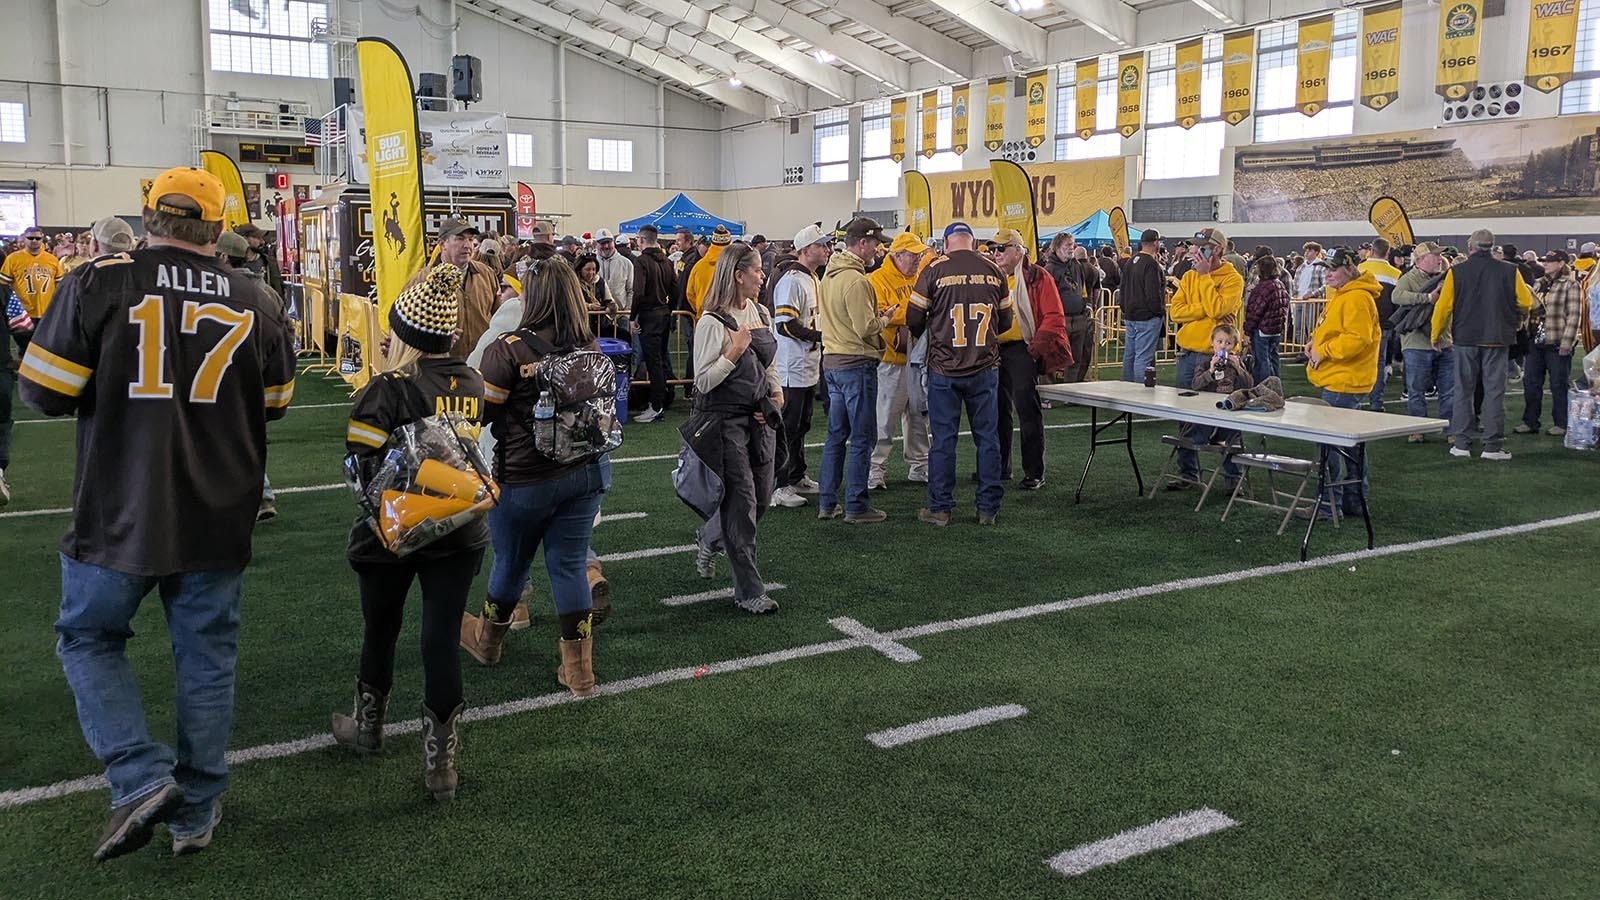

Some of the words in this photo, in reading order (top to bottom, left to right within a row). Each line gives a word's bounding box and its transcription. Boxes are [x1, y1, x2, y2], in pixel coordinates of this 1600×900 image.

[1535, 0, 1576, 18] WAC
[1365, 28, 1398, 45] WAC
[1532, 45, 1572, 58] 1967
[1441, 55, 1477, 69] 1966
[1364, 67, 1396, 80] 1966
[1300, 77, 1326, 88] 1961
[1178, 94, 1200, 105] 1959
[1224, 87, 1250, 99] 1960
[1078, 108, 1097, 118] 1958
[1119, 104, 1140, 114] 1958
[1028, 117, 1045, 126] 1956
[378, 135, 401, 150] BUD
[375, 146, 405, 163] LIGHT
[951, 175, 1056, 219] WYOG
[426, 214, 502, 232] LHT
[522, 206, 532, 236] TOY
[24, 274, 51, 295] 17
[156, 264, 231, 297] ALLEN
[969, 274, 986, 285] JOE
[950, 303, 993, 348] 17
[128, 294, 255, 403] 17
[435, 396, 478, 419] ALLEN
